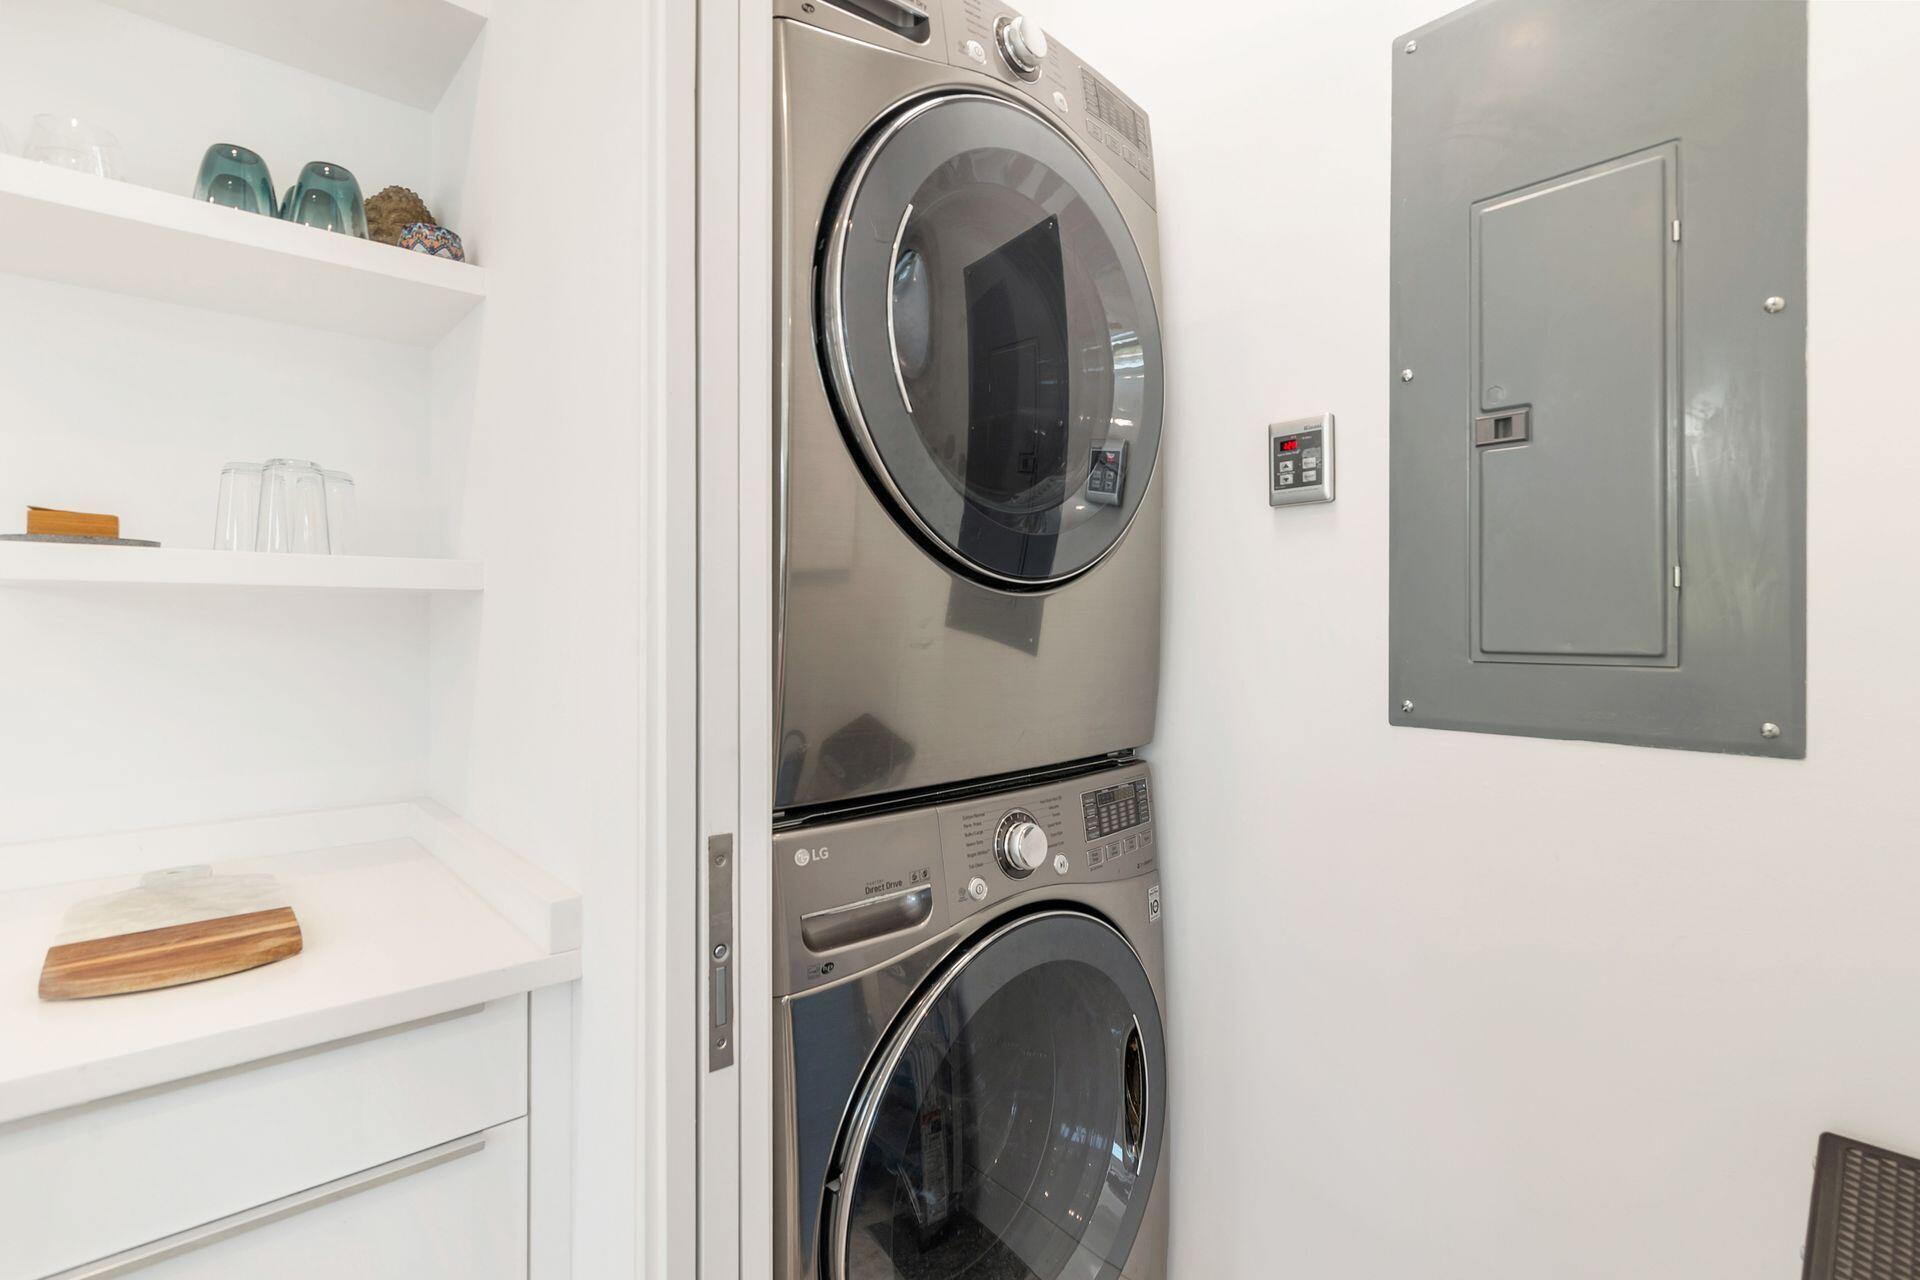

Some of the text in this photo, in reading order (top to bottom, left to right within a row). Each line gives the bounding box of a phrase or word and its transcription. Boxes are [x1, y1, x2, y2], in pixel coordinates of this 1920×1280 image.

[812, 847, 829, 861] LG
[865, 883, 885, 895] Direct
[886, 880, 903, 890] Drive
